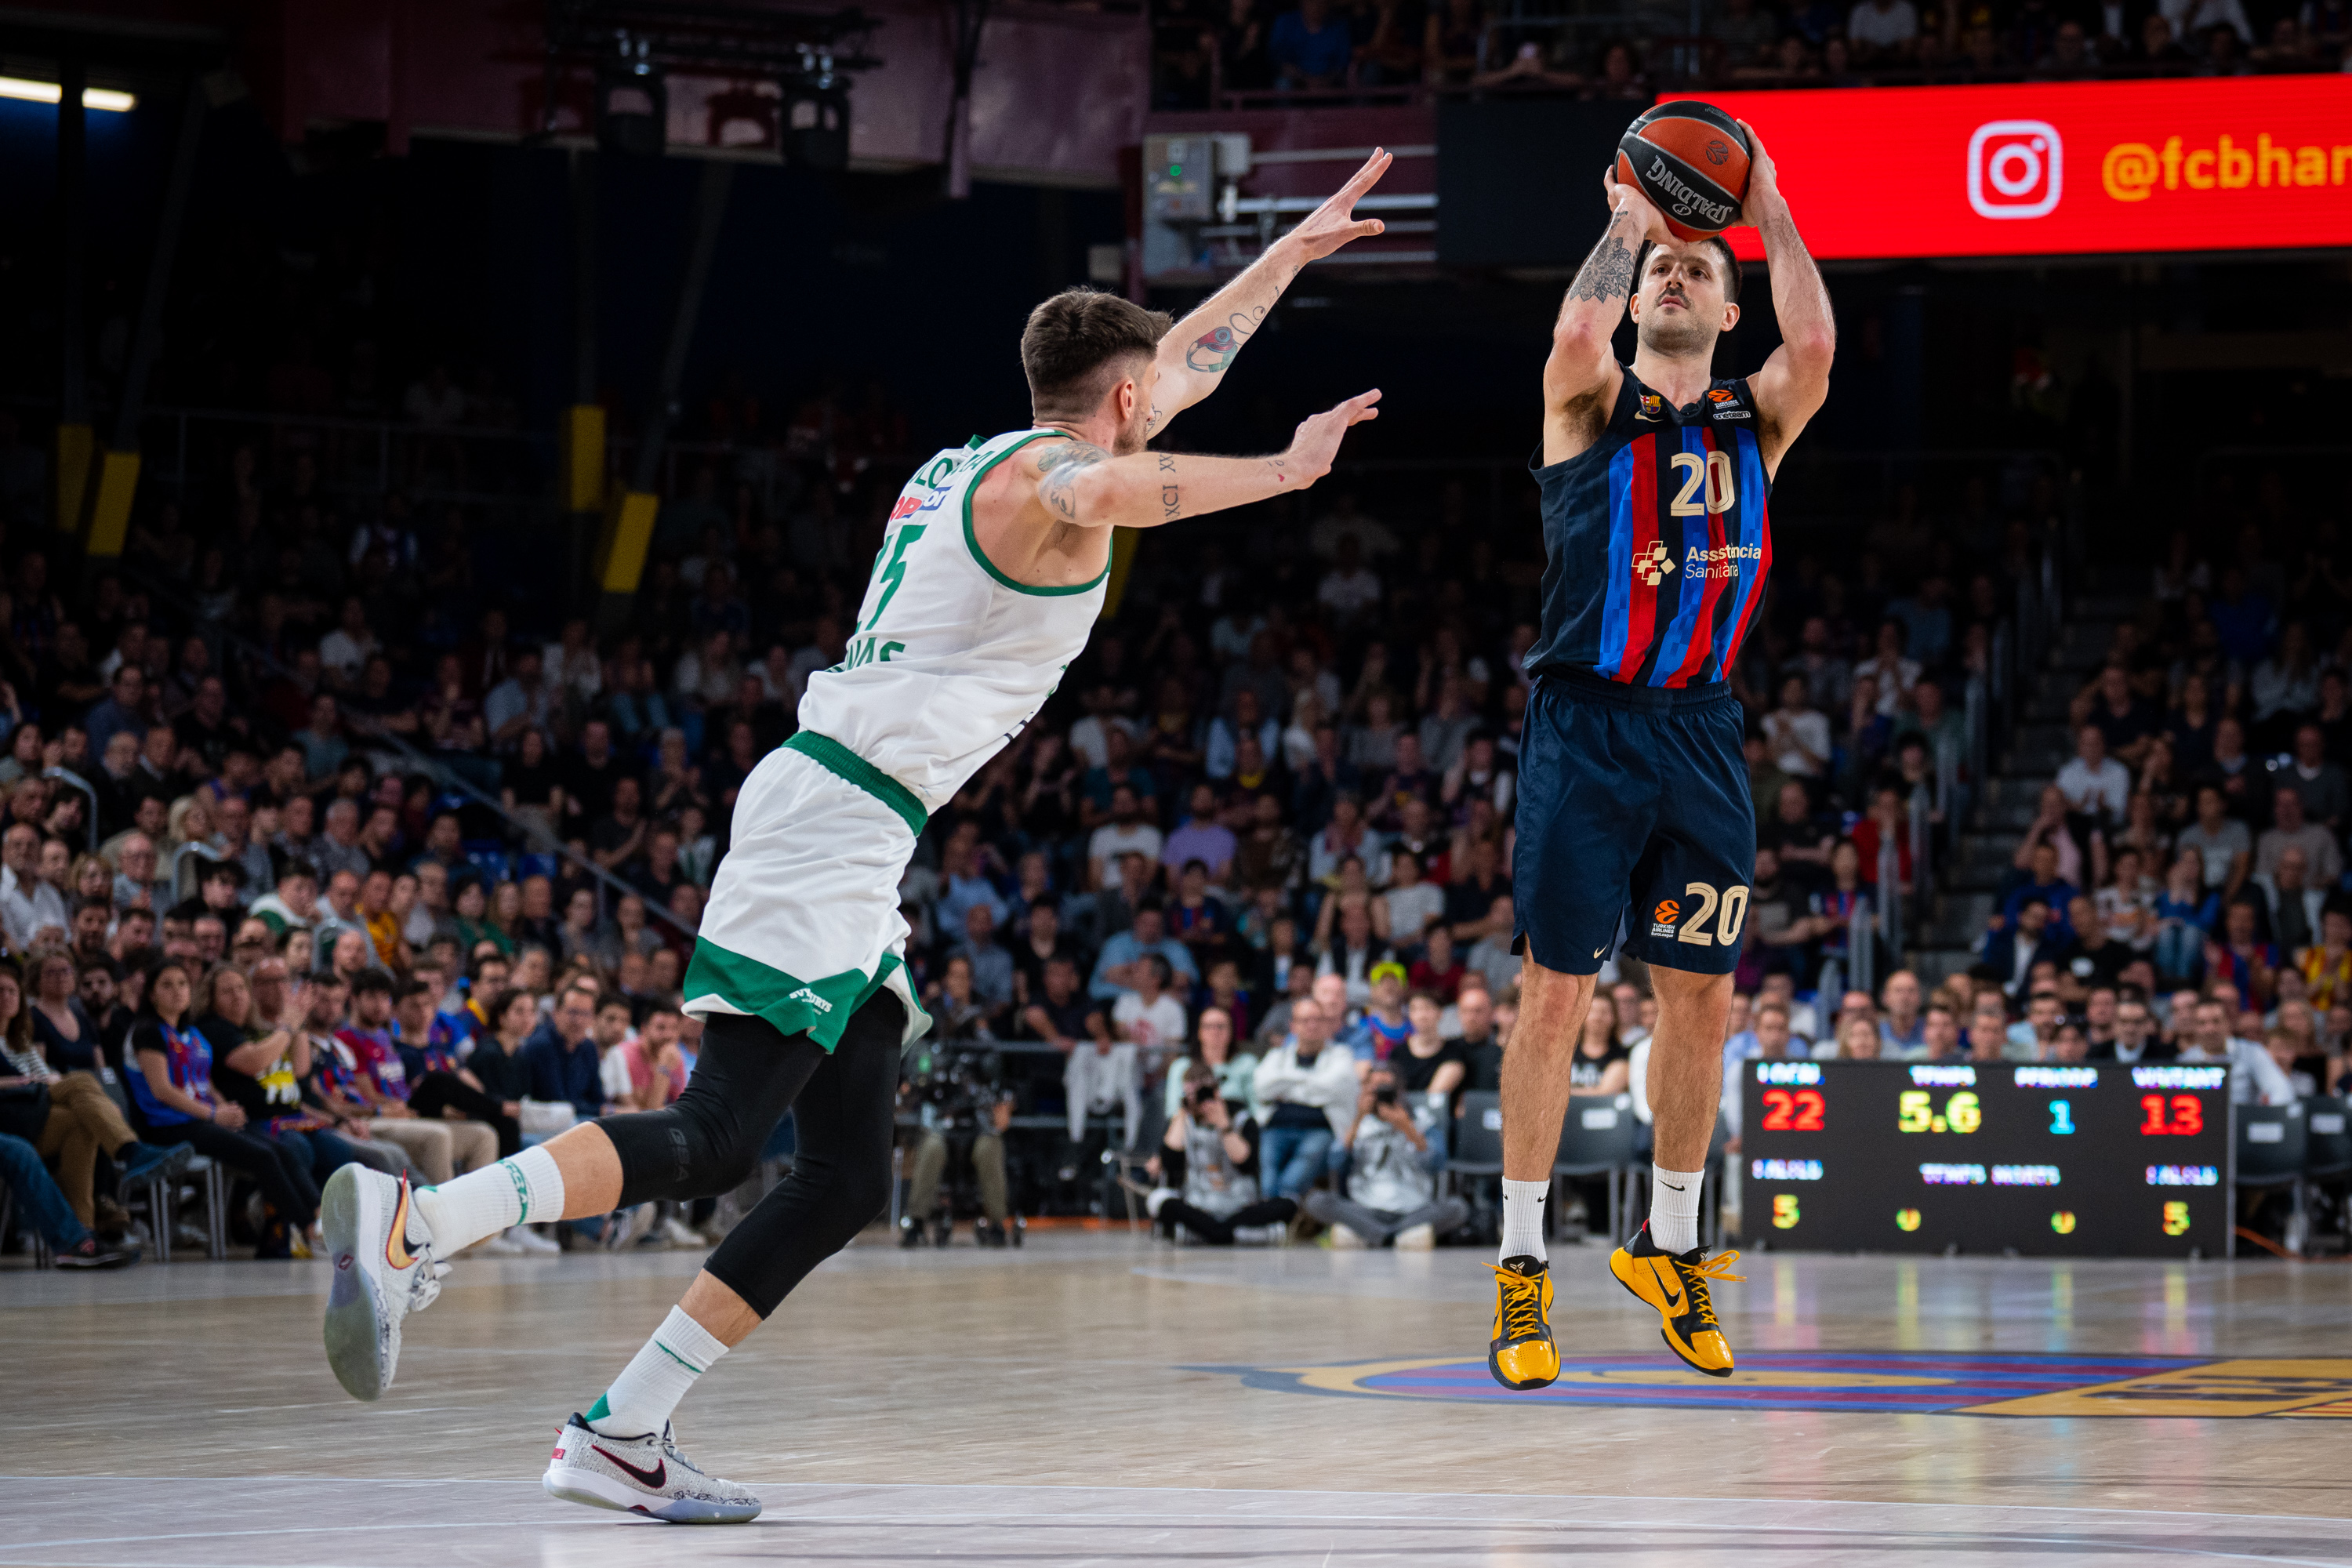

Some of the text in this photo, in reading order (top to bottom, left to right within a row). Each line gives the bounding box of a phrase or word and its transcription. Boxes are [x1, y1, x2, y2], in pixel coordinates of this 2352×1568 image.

[1646, 157, 1734, 224] SPALDING
[1671, 450, 1735, 517] 20
[1678, 882, 1750, 946] 20
[1762, 1089, 1825, 1131] 22
[1899, 1091, 1981, 1133] 5.6
[2049, 1099, 2076, 1134] 1
[2140, 1094, 2203, 1136] 13
[1772, 1194, 1800, 1229] 5
[2162, 1201, 2190, 1236] 5
